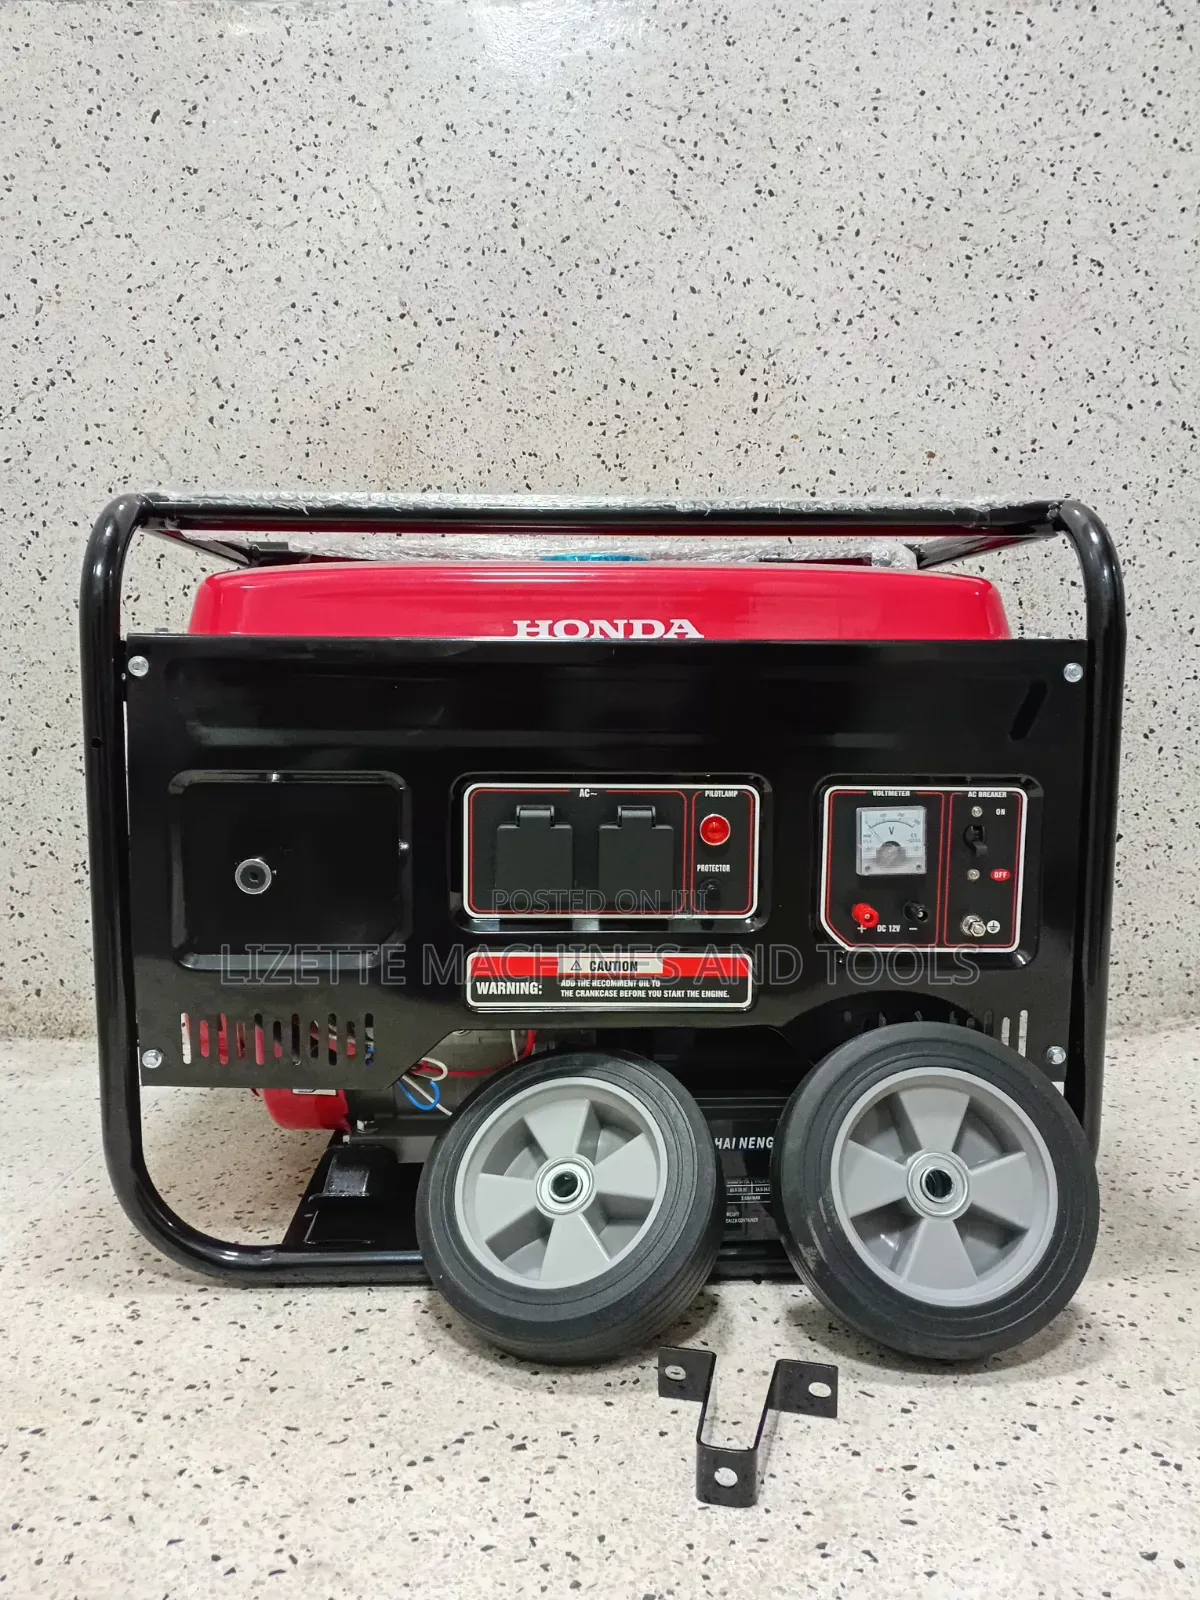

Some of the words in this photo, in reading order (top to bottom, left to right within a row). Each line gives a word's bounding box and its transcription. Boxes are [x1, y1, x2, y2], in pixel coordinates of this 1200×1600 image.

[512, 619, 705, 640] HONDA
[704, 789, 738, 798] PILOTLAMP
[995, 808, 1006, 816] ON
[888, 826, 895, 835] V
[696, 864, 731, 872] PROTECTOR
[994, 871, 1008, 879] OFF
[877, 924, 888, 933] DC
[888, 924, 901, 933] 12V
[589, 960, 638, 972] CAUTION
[476, 982, 543, 995] WARNING:
[701, 990, 730, 998] ENGINE.
[738, 1136, 774, 1149] NENG
